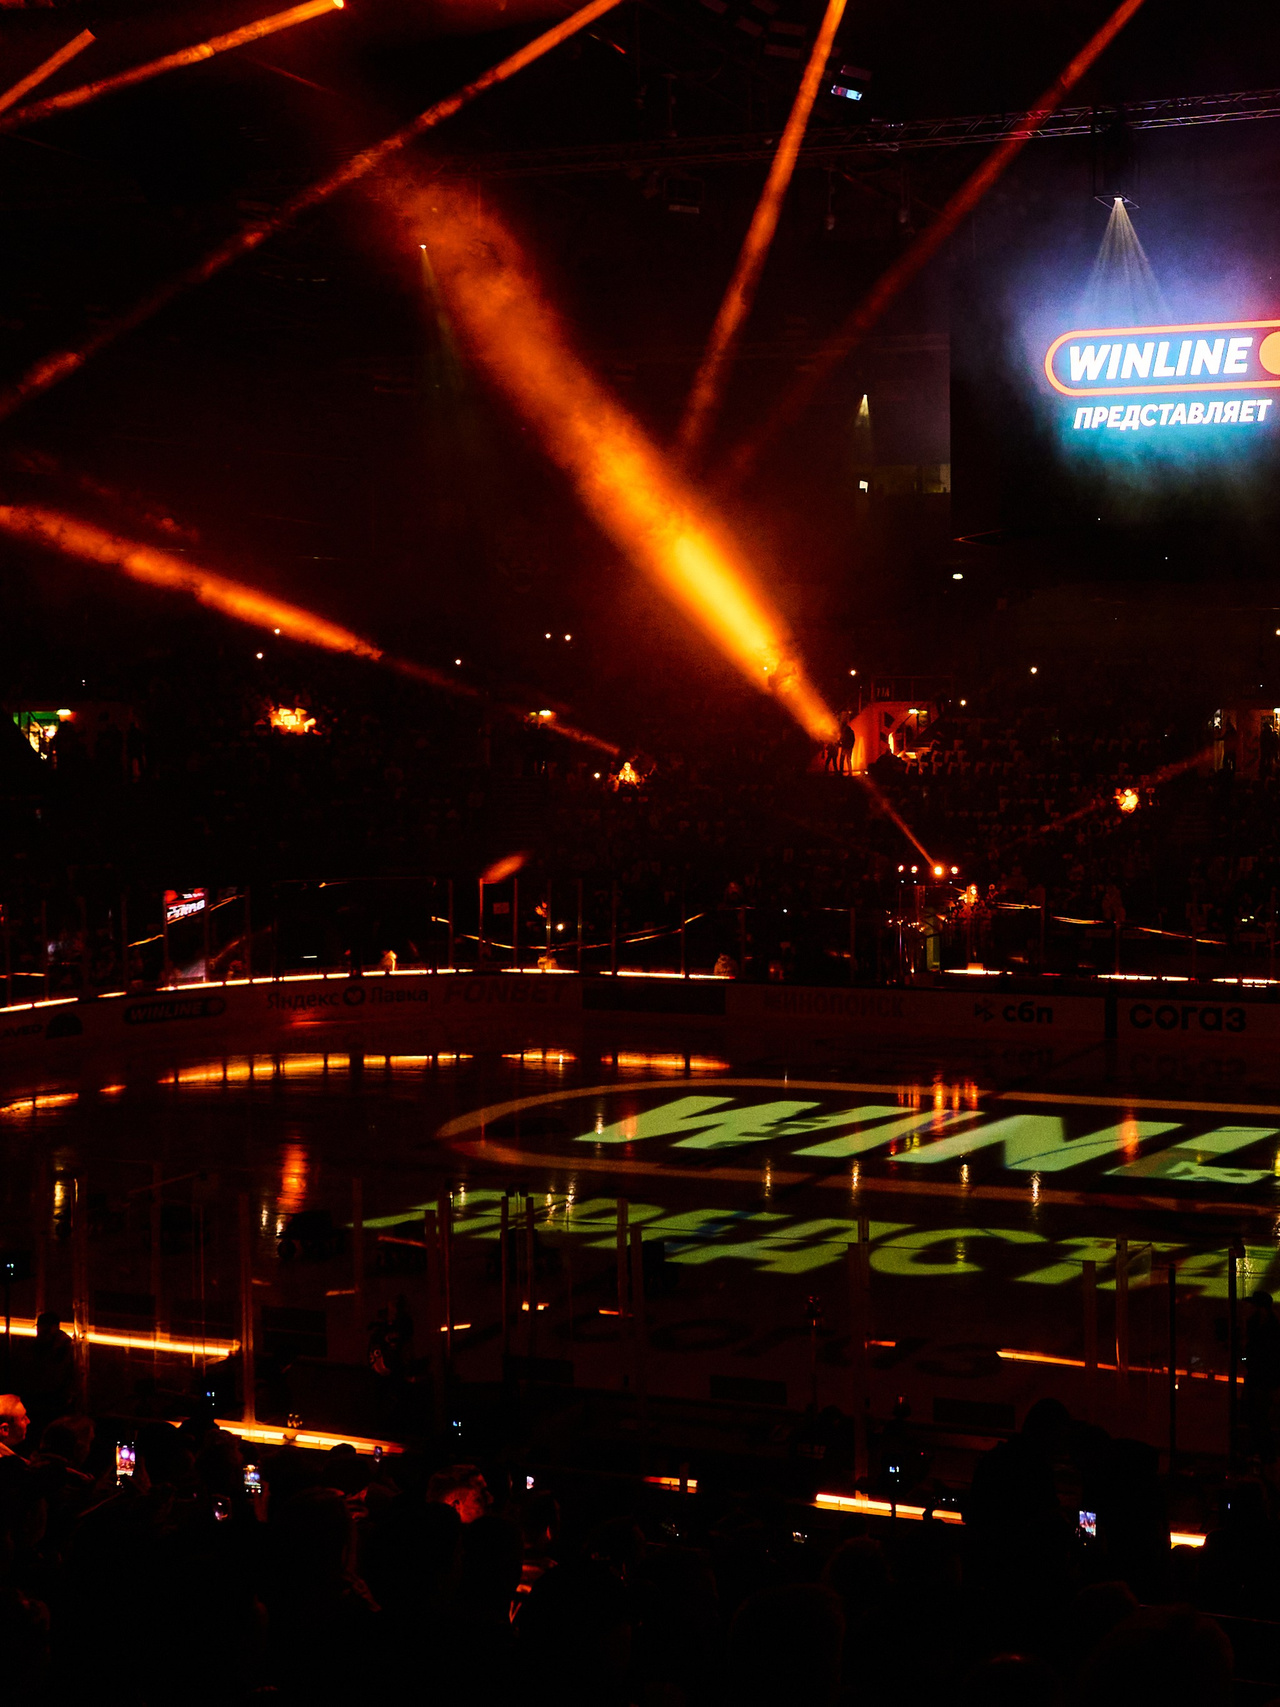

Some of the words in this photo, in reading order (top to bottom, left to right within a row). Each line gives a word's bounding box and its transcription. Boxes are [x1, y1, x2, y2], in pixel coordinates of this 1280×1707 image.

[1068, 336, 1254, 382] WINLINE
[1073, 398, 1273, 431] ПРЕДСТАВЛЯЕТ
[267, 990, 339, 1009] Яндекс
[370, 986, 429, 1004] Лавка
[1001, 1001, 1054, 1024] сбп
[1128, 1003, 1247, 1033] согаз
